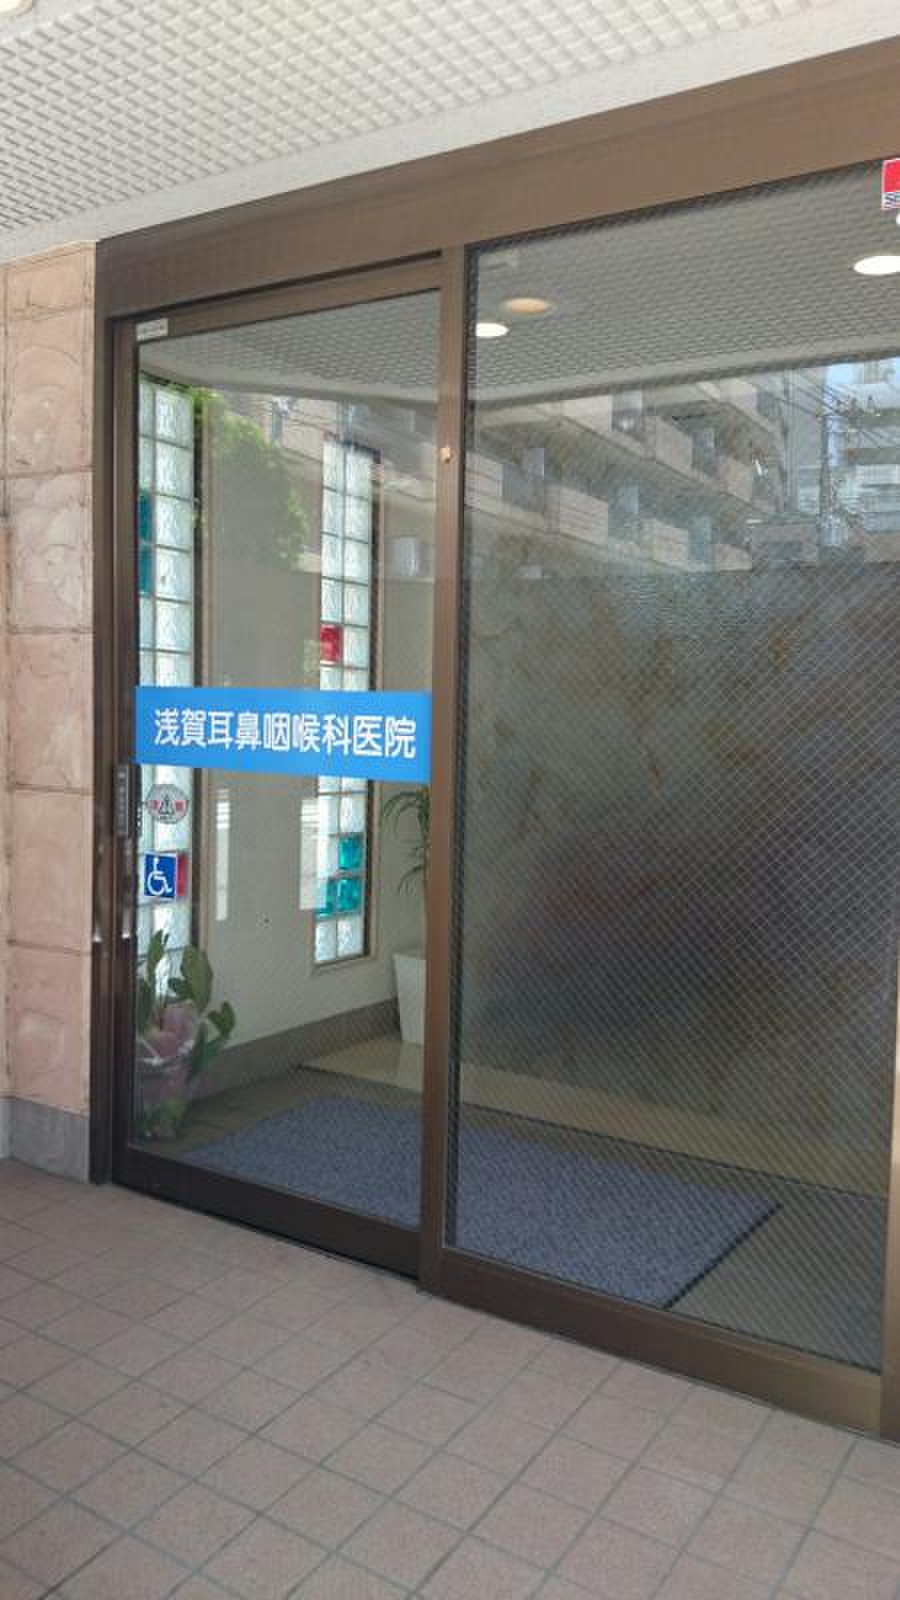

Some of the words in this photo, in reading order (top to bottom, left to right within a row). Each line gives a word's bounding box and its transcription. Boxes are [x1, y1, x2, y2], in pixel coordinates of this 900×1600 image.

[154, 708, 417, 758] 浅賀耳鼻咽喉科医院
